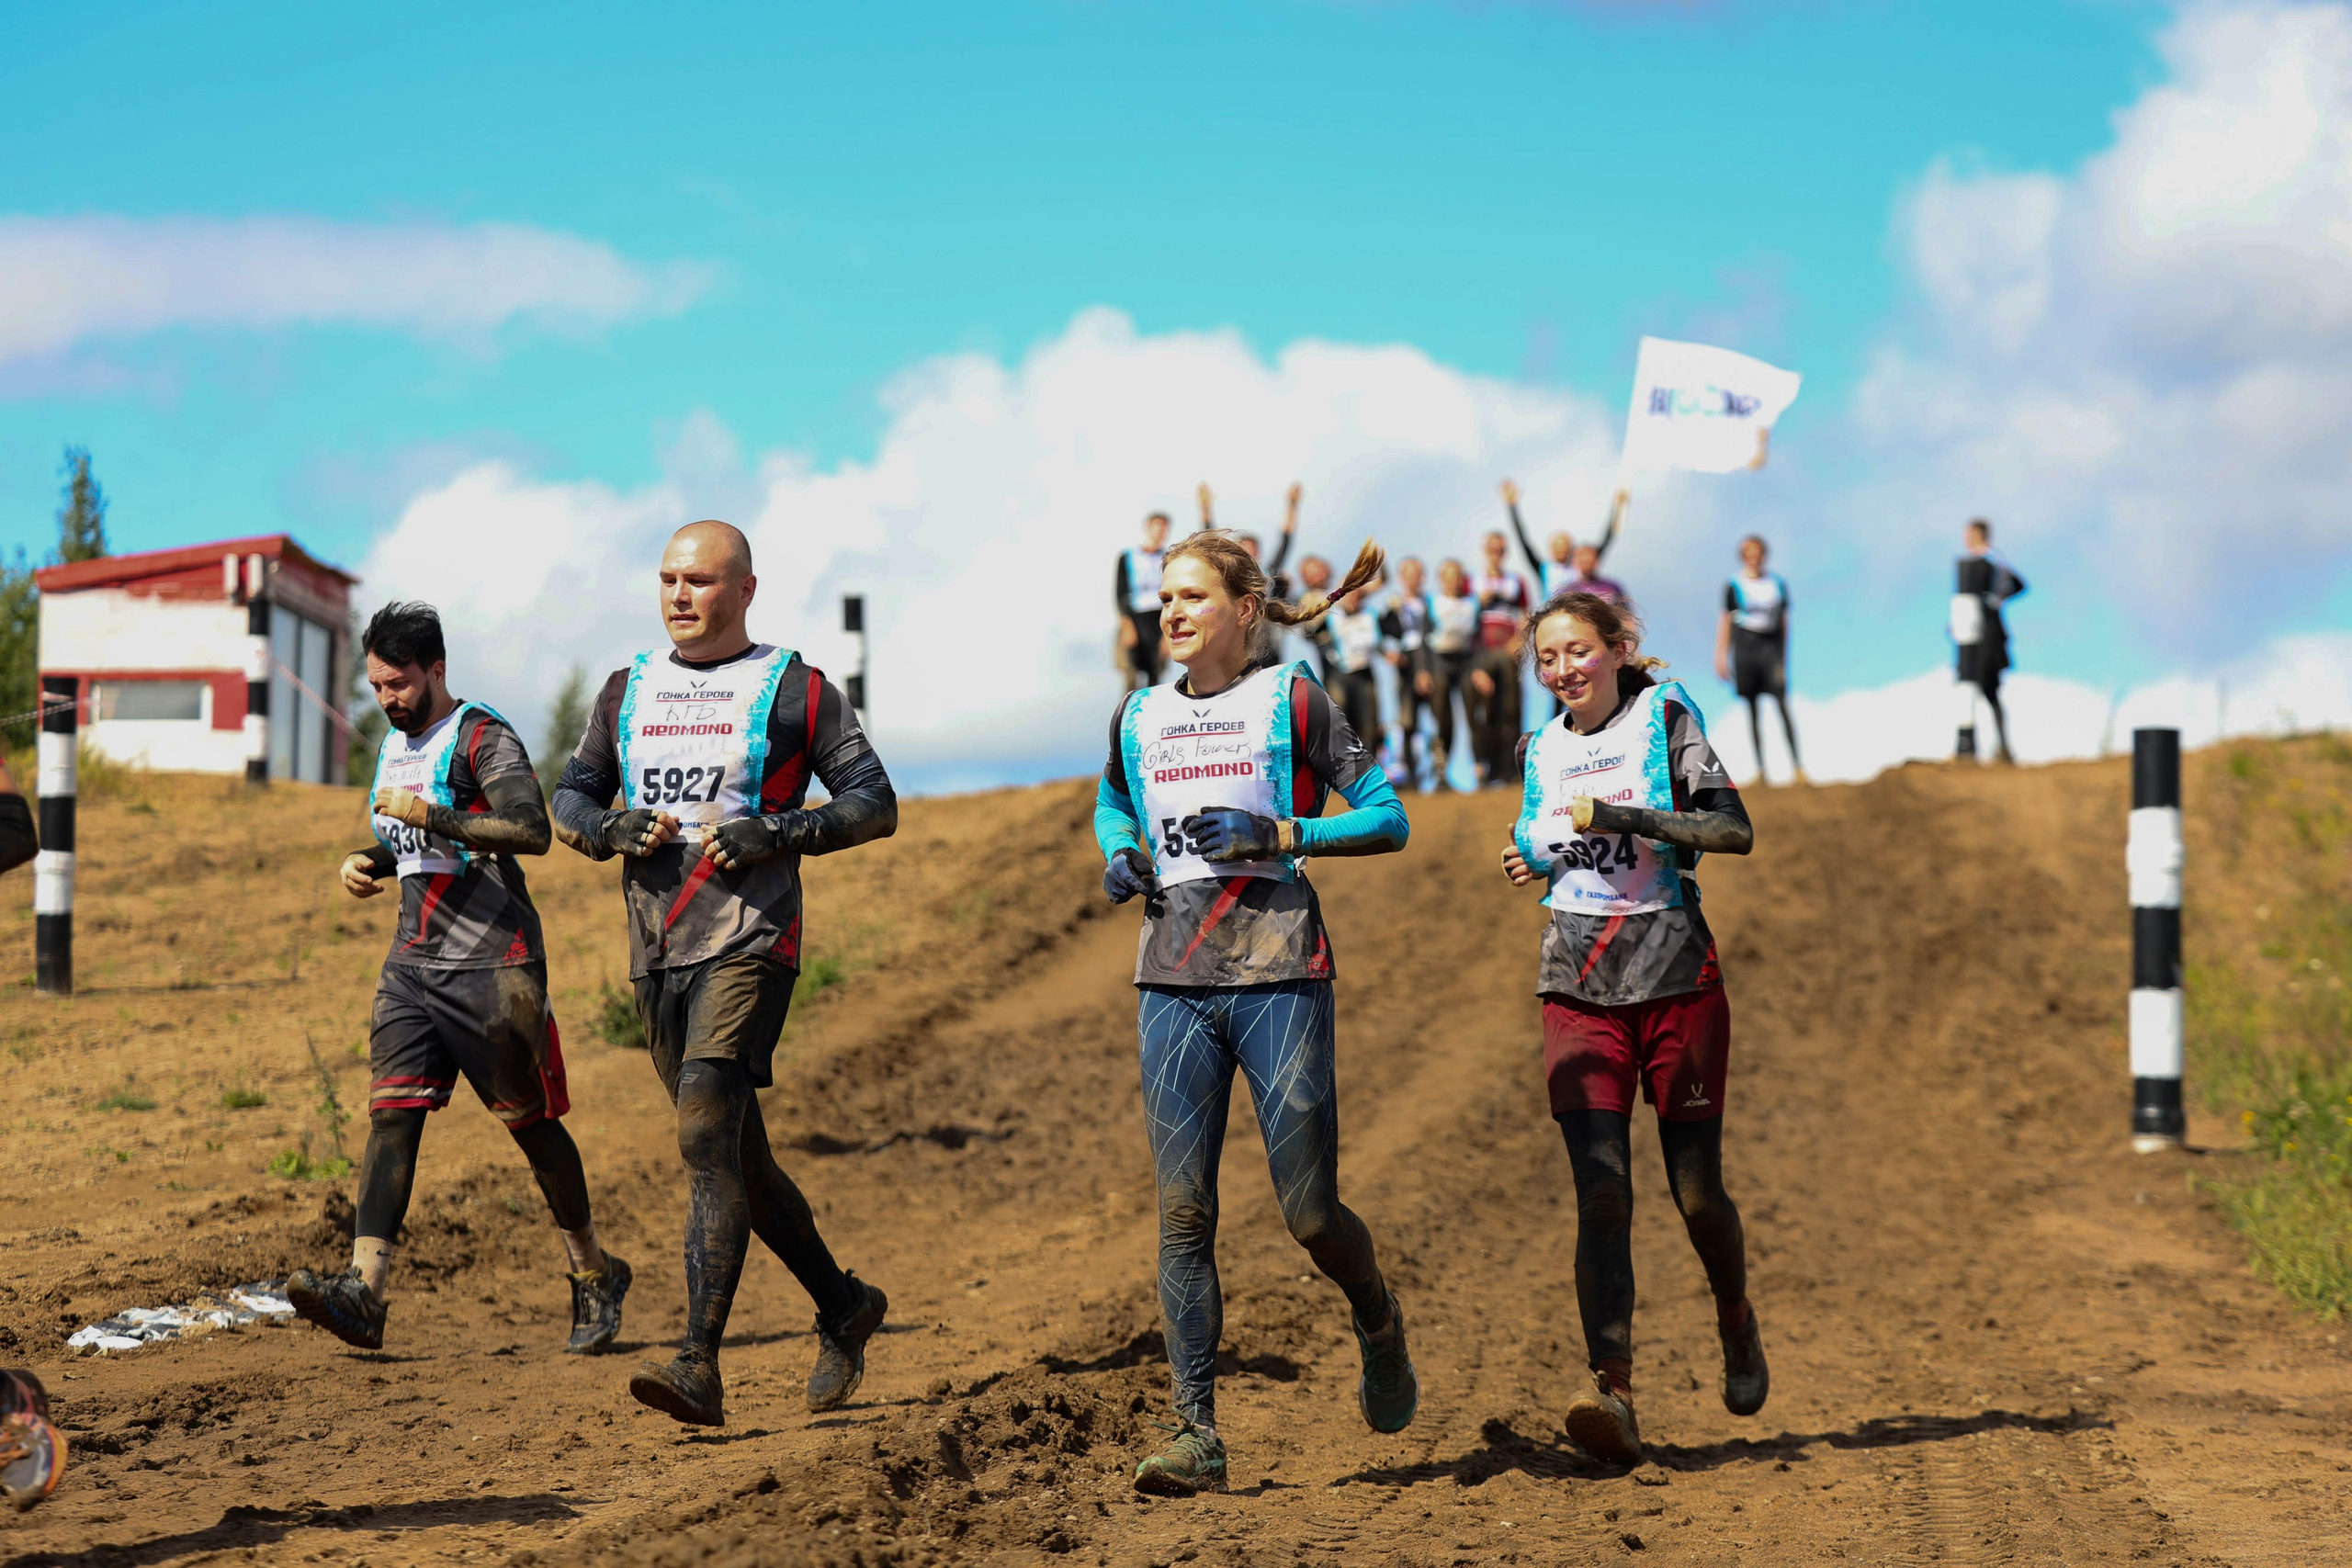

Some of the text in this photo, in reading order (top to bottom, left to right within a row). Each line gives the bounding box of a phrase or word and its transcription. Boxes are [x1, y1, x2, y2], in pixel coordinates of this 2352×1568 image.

[655, 691, 734, 700] ГОНКА ГЕРОЕВ
[666, 702, 718, 721] КГБ
[642, 723, 733, 737] REDMOND
[1160, 721, 1245, 737] ГОНКА ГЕРОЕВ
[1154, 761, 1253, 784] REDMOND
[1561, 763, 1590, 778] ГОНКА
[643, 766, 726, 805] 5927
[1161, 815, 1204, 858] 59
[1548, 833, 1638, 874] 5924
[1586, 891, 1629, 901] ГАЗПРОМБАНК
